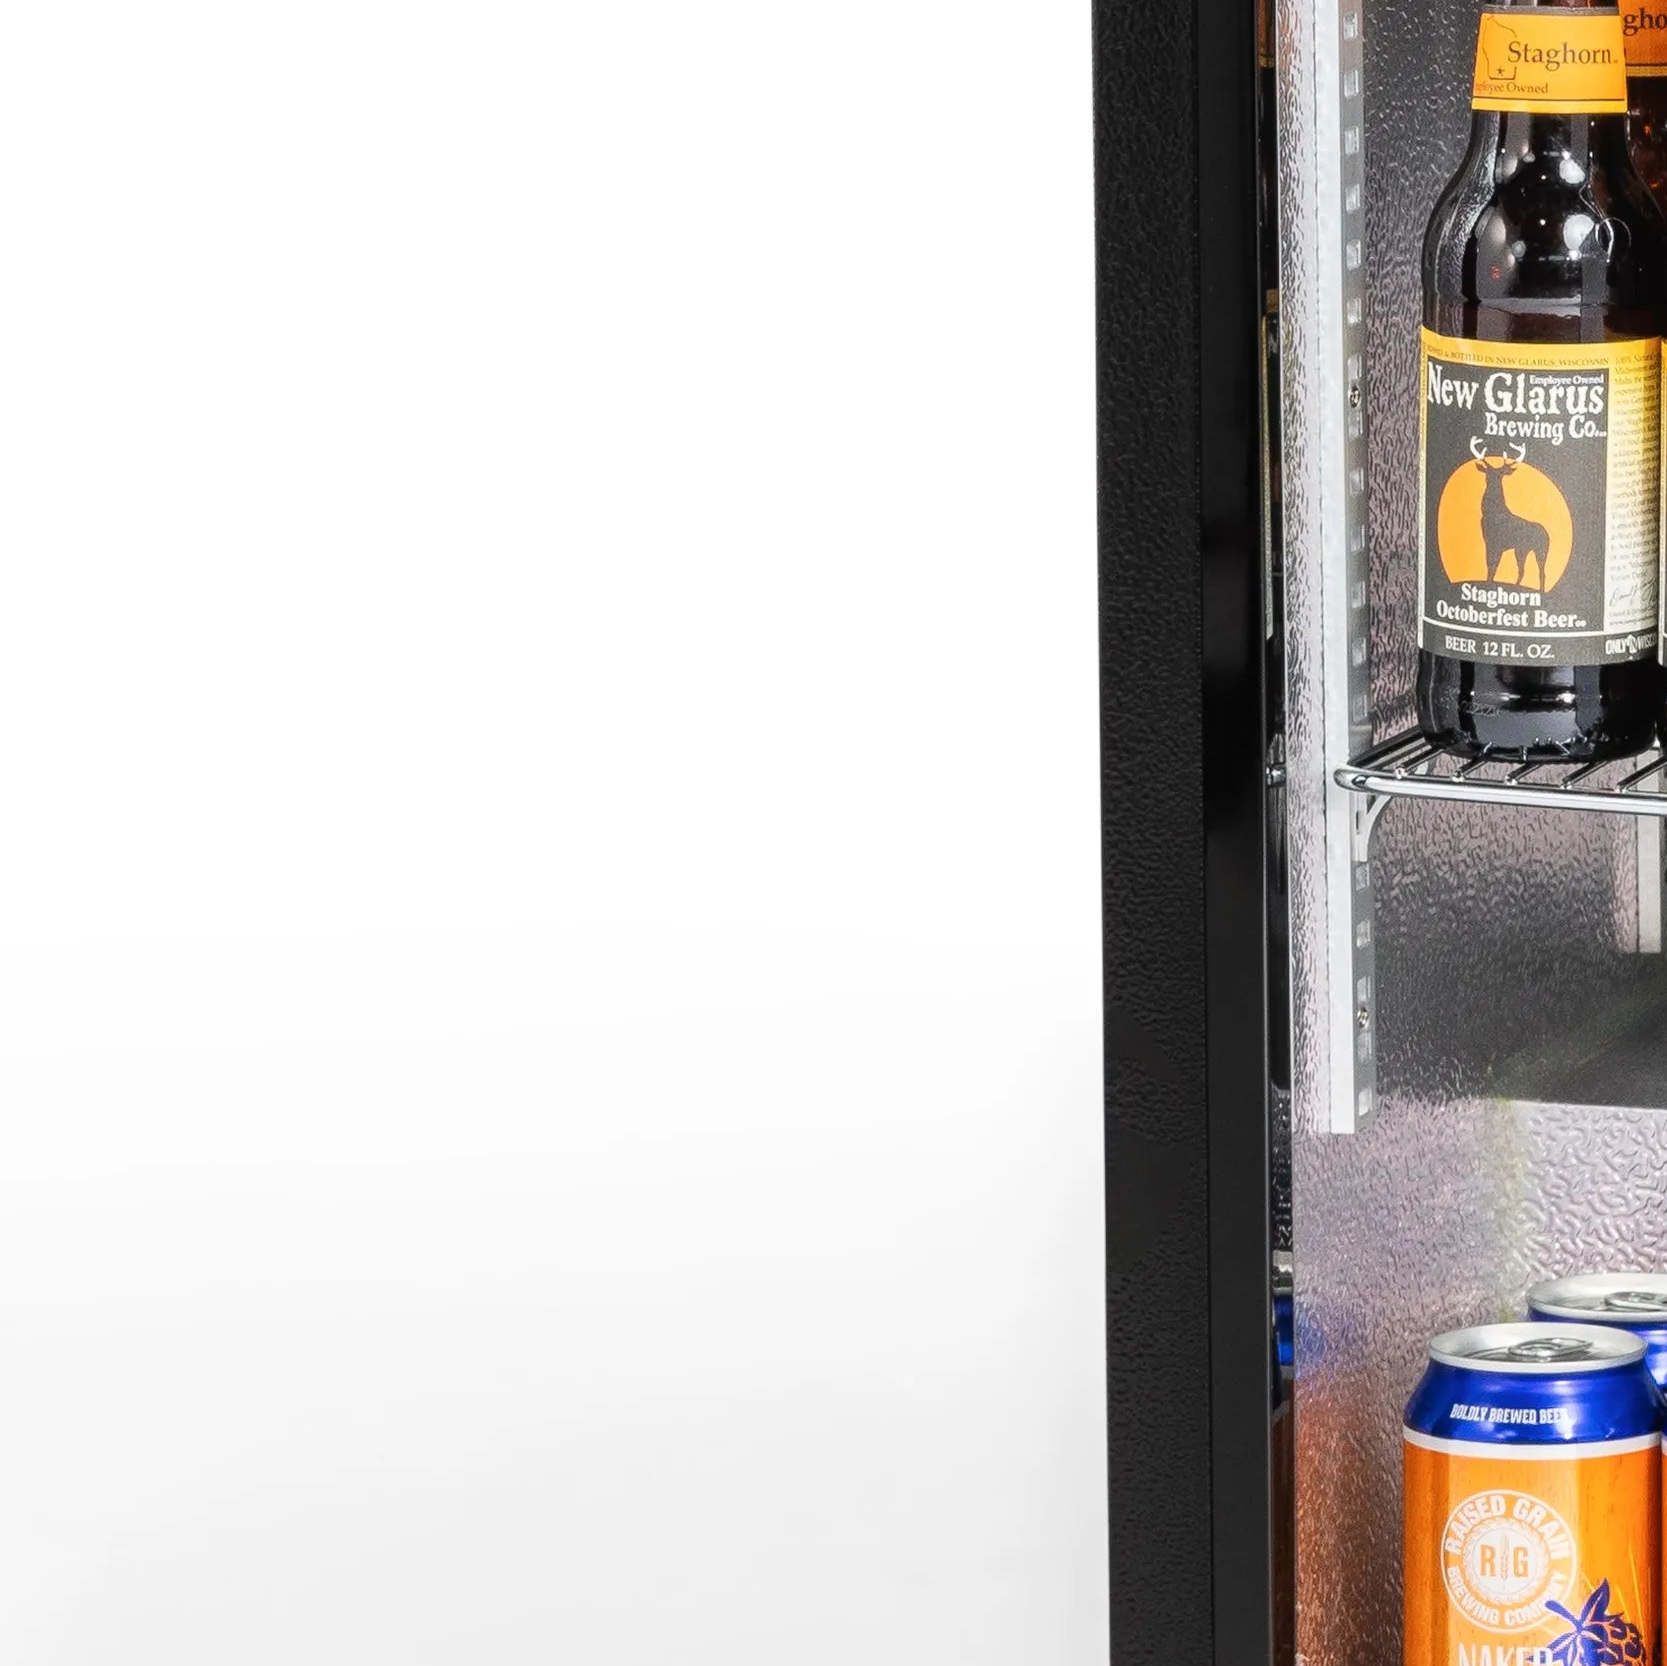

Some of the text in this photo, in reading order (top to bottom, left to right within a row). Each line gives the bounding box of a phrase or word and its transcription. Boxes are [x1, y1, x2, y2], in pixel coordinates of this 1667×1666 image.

[1506, 82, 1549, 94] Owned
[1427, 362, 1605, 415] New Glarus
[1485, 412, 1564, 445] Brewing
[1461, 583, 1541, 609] Staghorn
[1436, 599, 1529, 627] Octoberfest
[1450, 1403, 1538, 1425] BOLDLY BREWED
